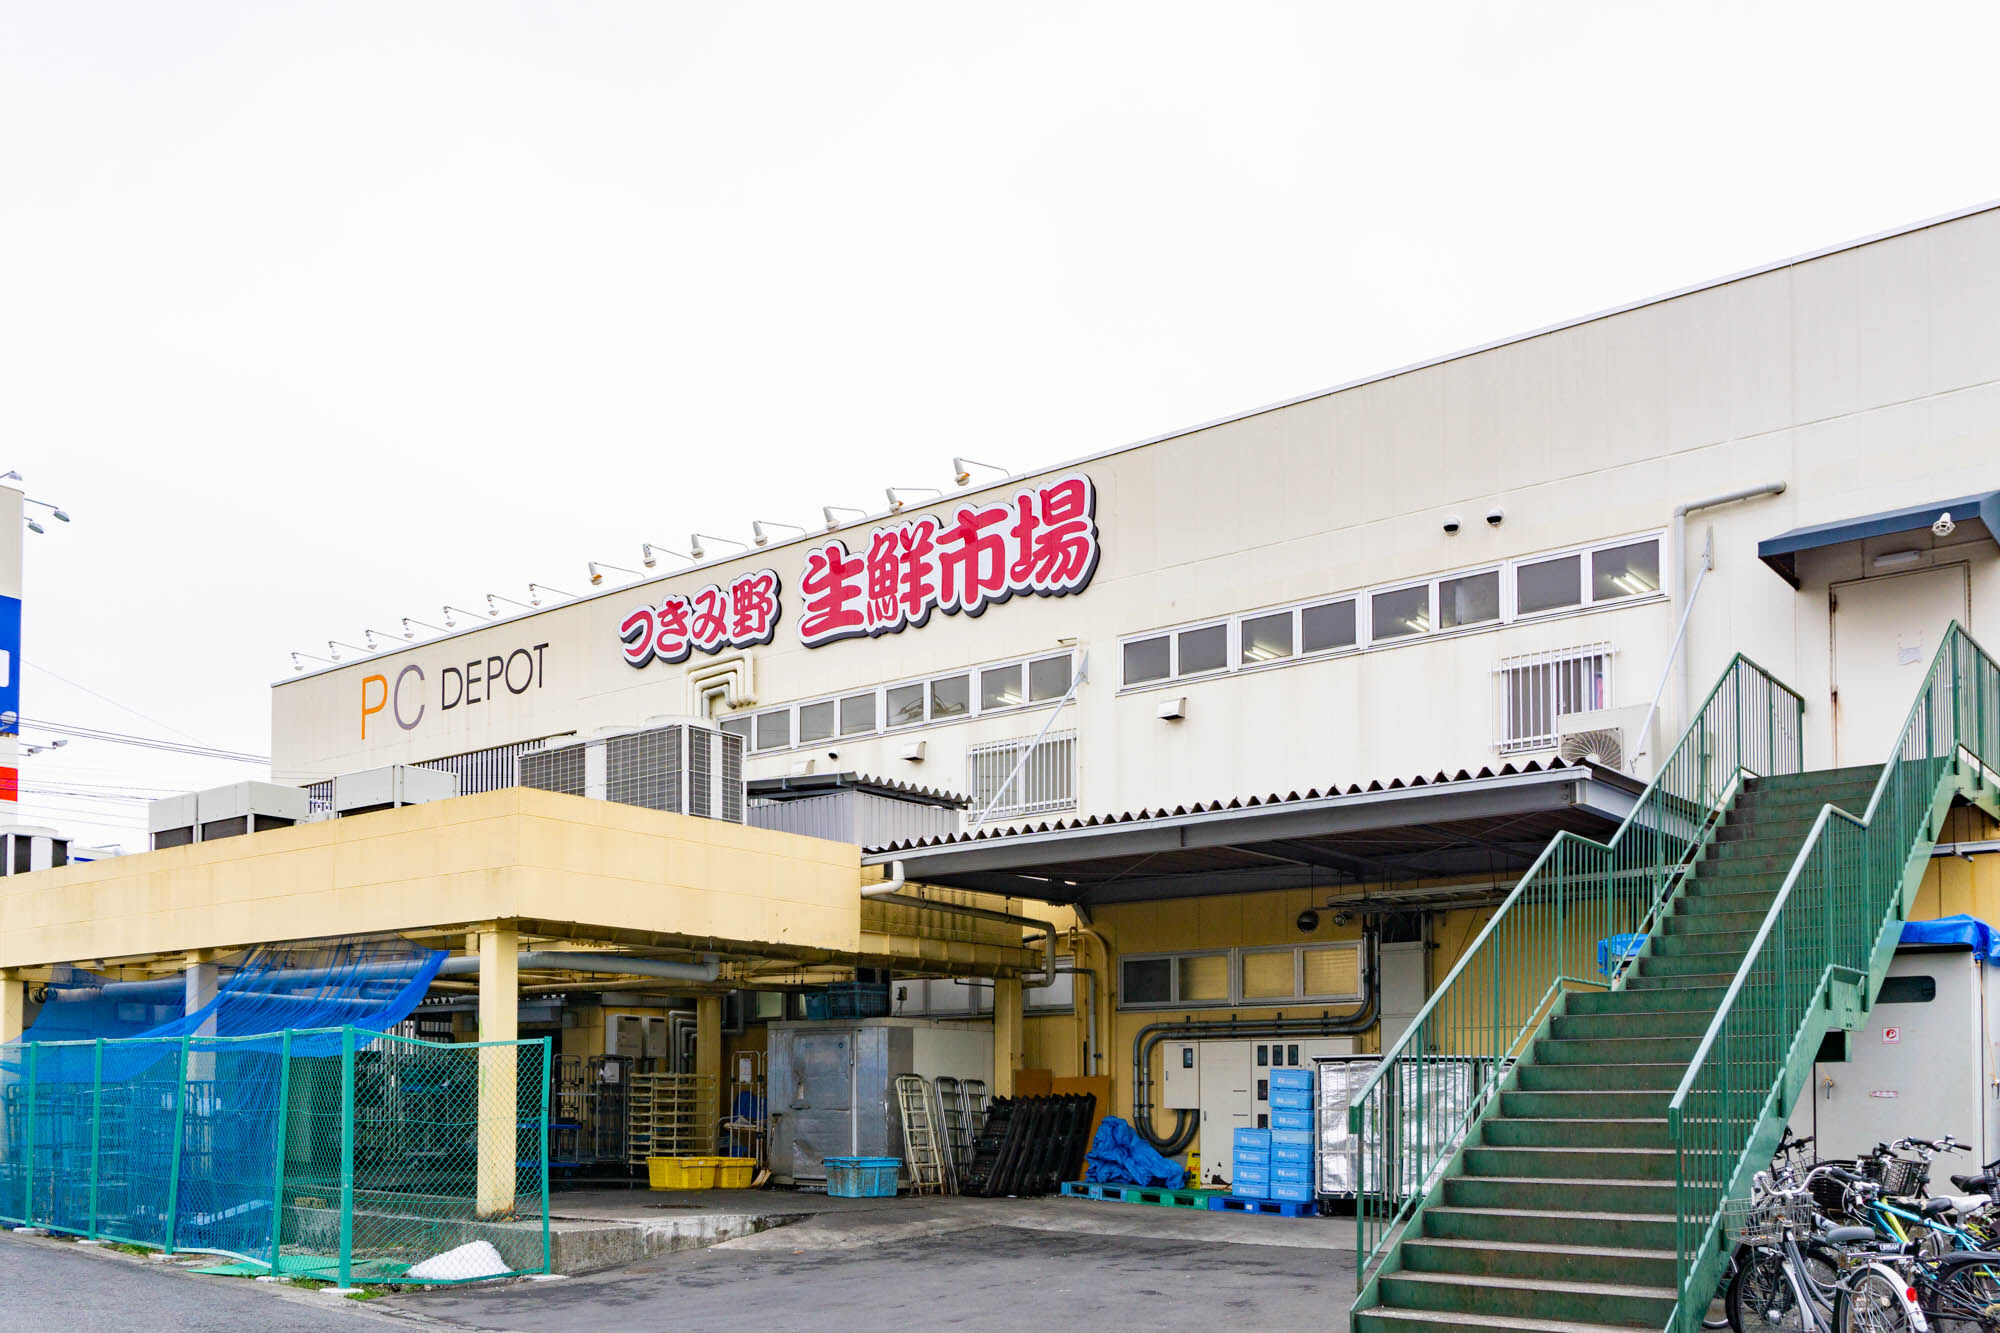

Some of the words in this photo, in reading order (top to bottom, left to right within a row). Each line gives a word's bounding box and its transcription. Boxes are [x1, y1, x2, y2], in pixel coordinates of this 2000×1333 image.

[620, 573, 776, 658] つきみ野
[801, 478, 1091, 638] 生鮮市場
[361, 664, 425, 740] PC
[442, 642, 549, 711] DEPOT
